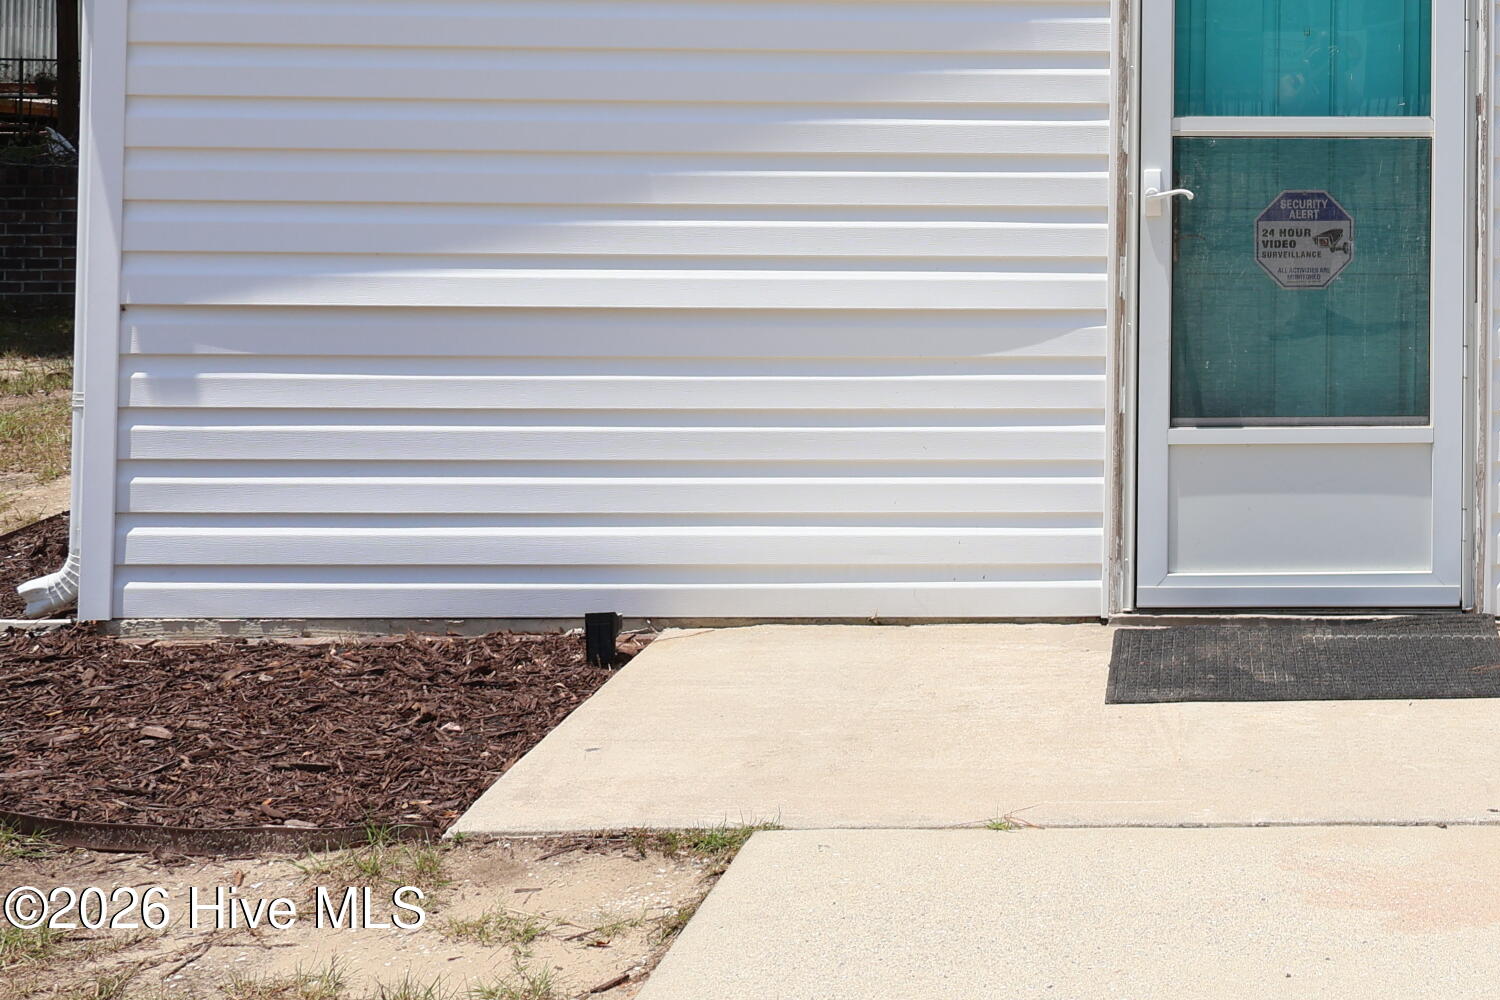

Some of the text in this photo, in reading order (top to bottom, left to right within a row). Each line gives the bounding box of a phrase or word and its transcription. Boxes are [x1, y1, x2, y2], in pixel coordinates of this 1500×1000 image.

[1279, 199, 1329, 209] SECURITY
[1288, 209, 1321, 219] ALERT
[1261, 228, 1312, 237] 24 HOUR
[1261, 239, 1297, 249] VIDEO
[1261, 250, 1322, 259] SURVEILLANCE
